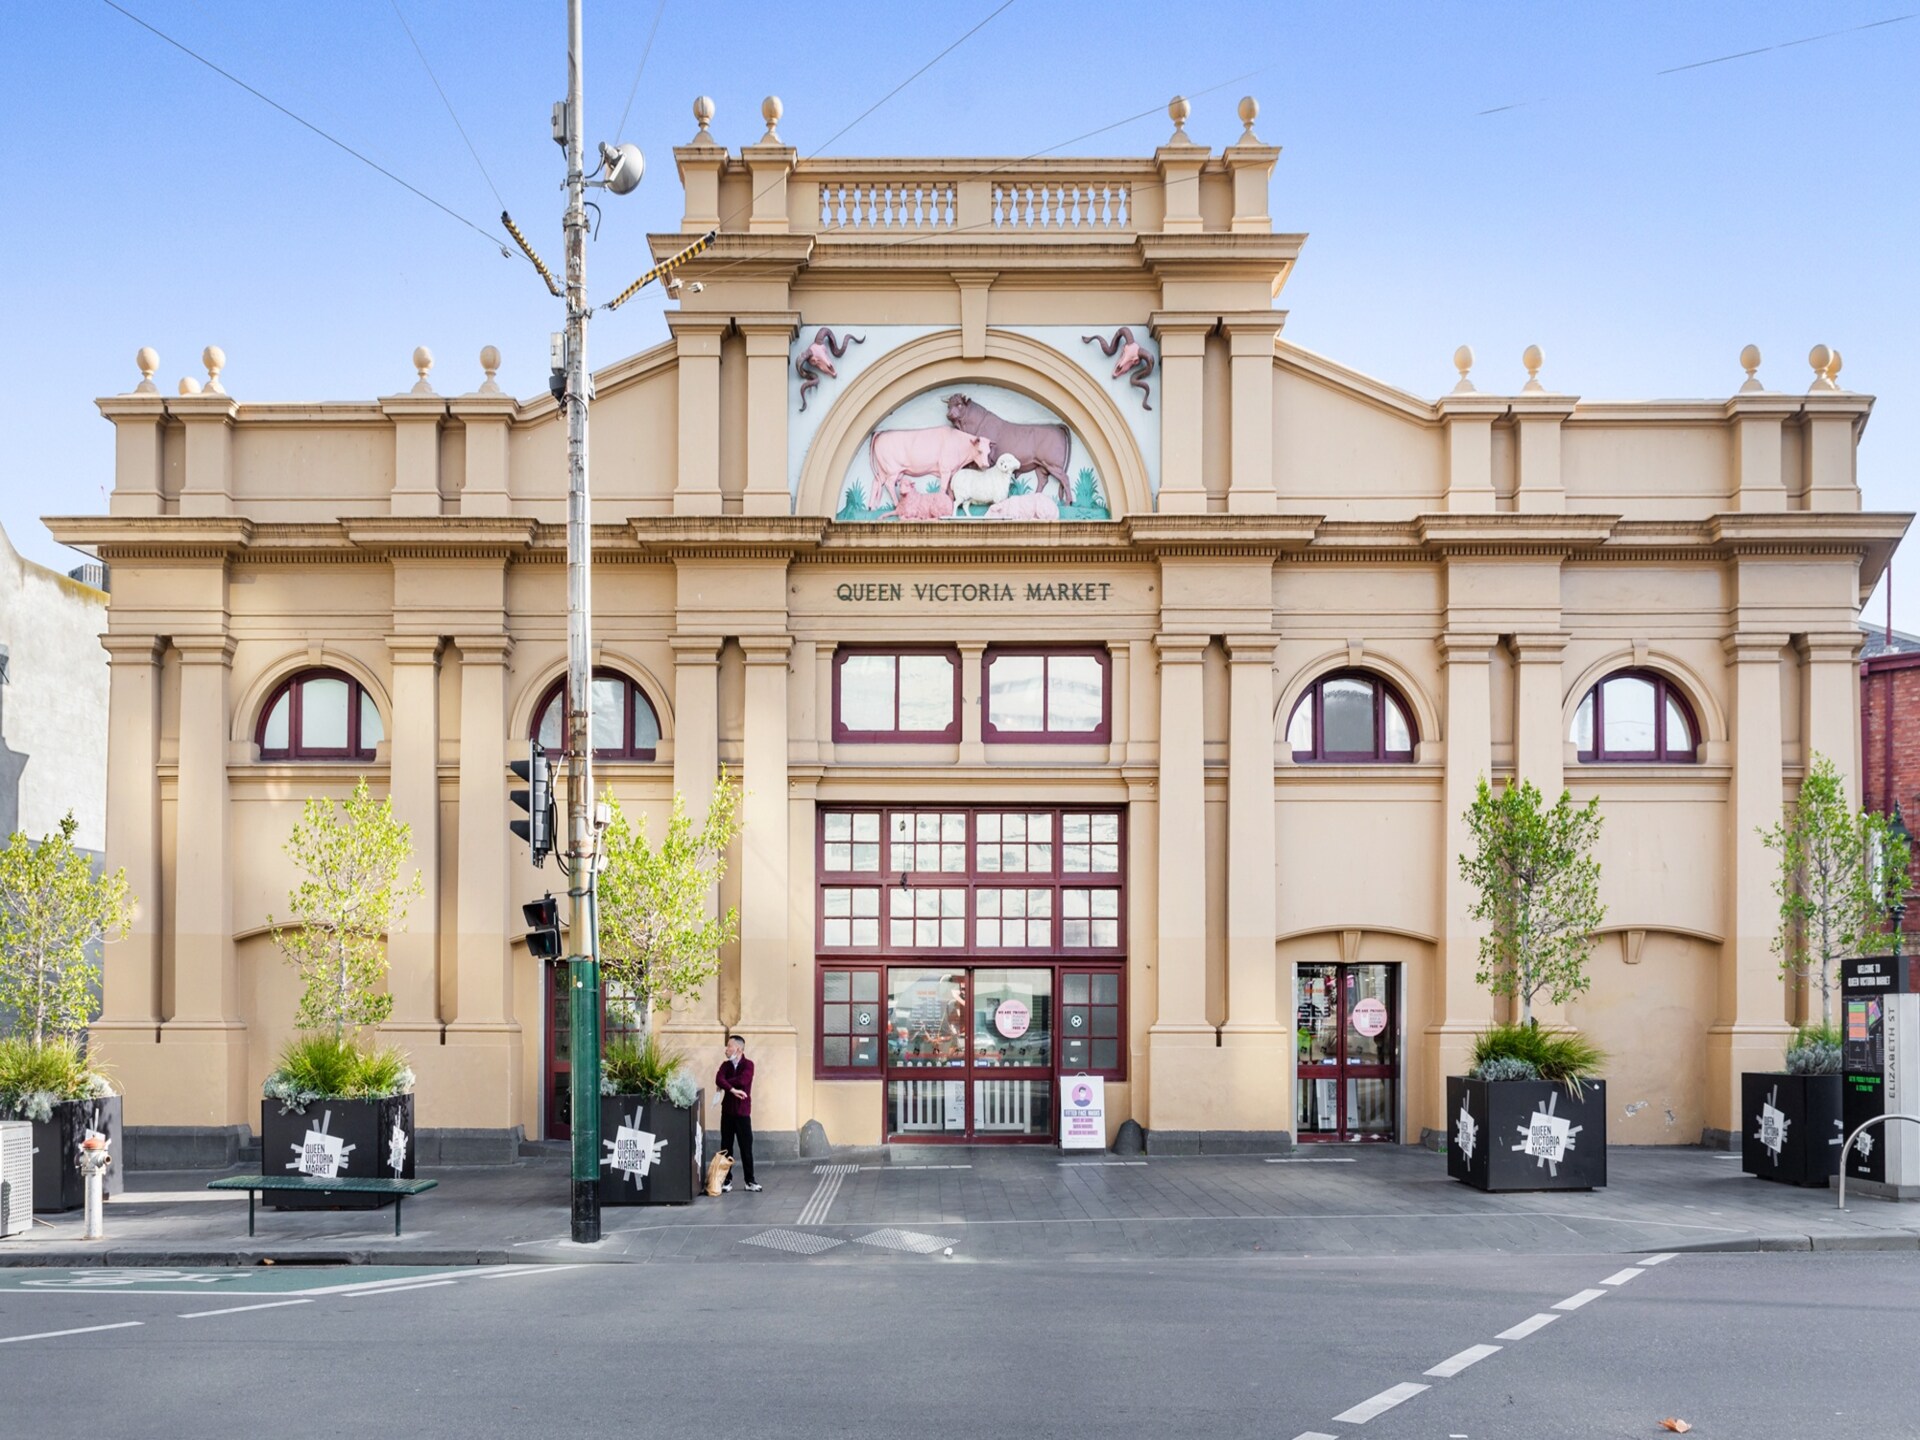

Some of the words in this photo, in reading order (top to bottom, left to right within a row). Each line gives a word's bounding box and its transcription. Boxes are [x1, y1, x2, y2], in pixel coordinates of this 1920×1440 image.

[837, 583, 901, 601] QUEEN
[914, 583, 1014, 601] VICTORIA
[1025, 583, 1110, 601] MARKET
[1888, 1007, 1895, 1022] ST
[1531, 1125, 1552, 1136] QUEEN
[617, 1140, 637, 1149] QUEEN
[1531, 1136, 1560, 1145] VICTORIA
[305, 1143, 325, 1153] QUEEN
[1531, 1146, 1557, 1156] MARKET
[305, 1154, 333, 1164] VICTORIA
[617, 1150, 645, 1160] VICTORIA
[305, 1164, 330, 1174] MARKET
[618, 1160, 642, 1170] MARKET
